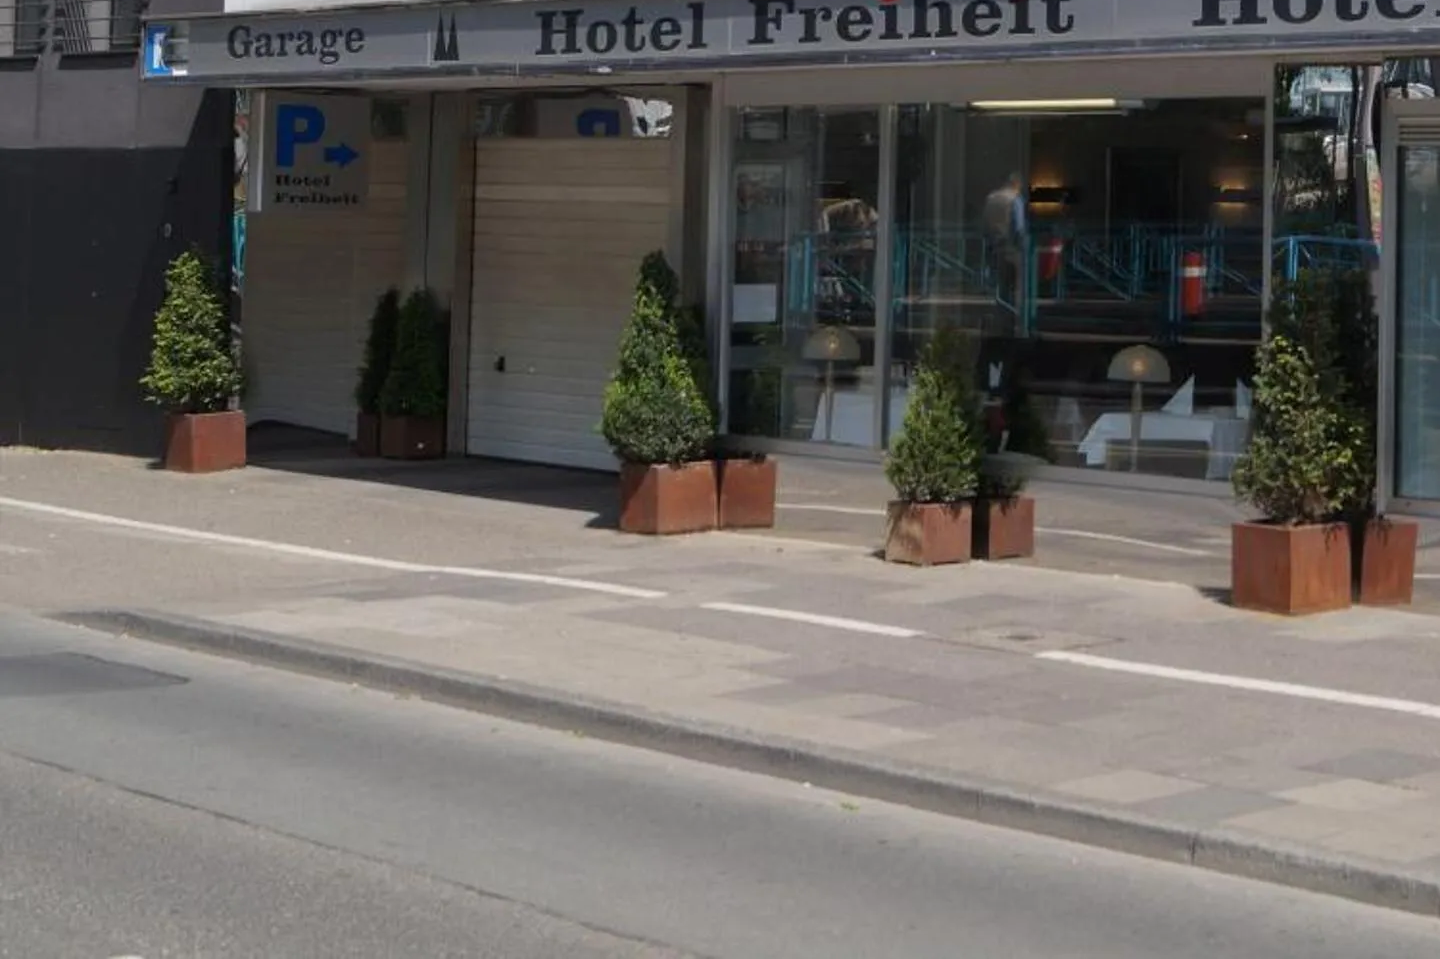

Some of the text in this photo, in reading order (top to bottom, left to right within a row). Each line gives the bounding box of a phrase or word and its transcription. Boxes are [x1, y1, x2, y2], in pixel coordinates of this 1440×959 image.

[226, 23, 365, 63] Garage
[535, 2, 706, 55] Hotel
[276, 104, 325, 167] P
[273, 191, 360, 205] Freiheit
[275, 174, 331, 187] Hotel
